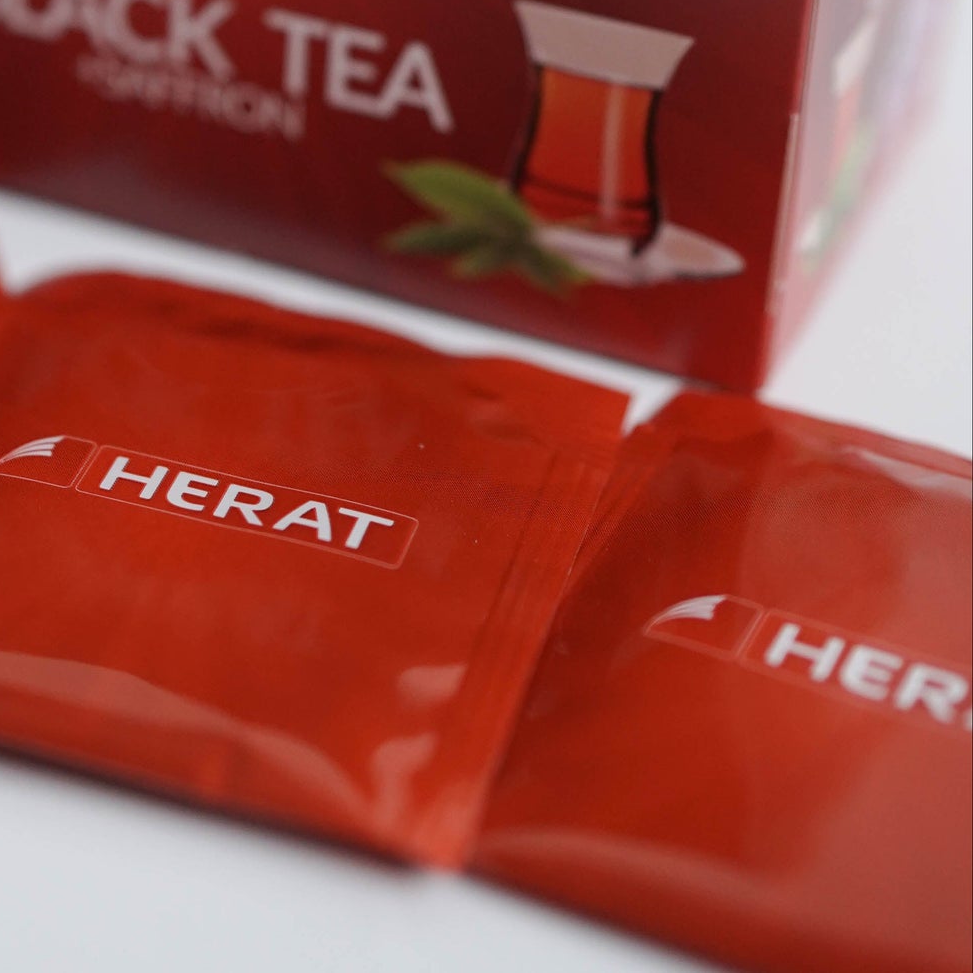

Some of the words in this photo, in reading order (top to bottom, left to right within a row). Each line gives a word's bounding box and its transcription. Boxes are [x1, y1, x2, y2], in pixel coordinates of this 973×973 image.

[265, 8, 455, 134] TEA
[99, 456, 394, 549] HERAT
[764, 622, 972, 733] HER
